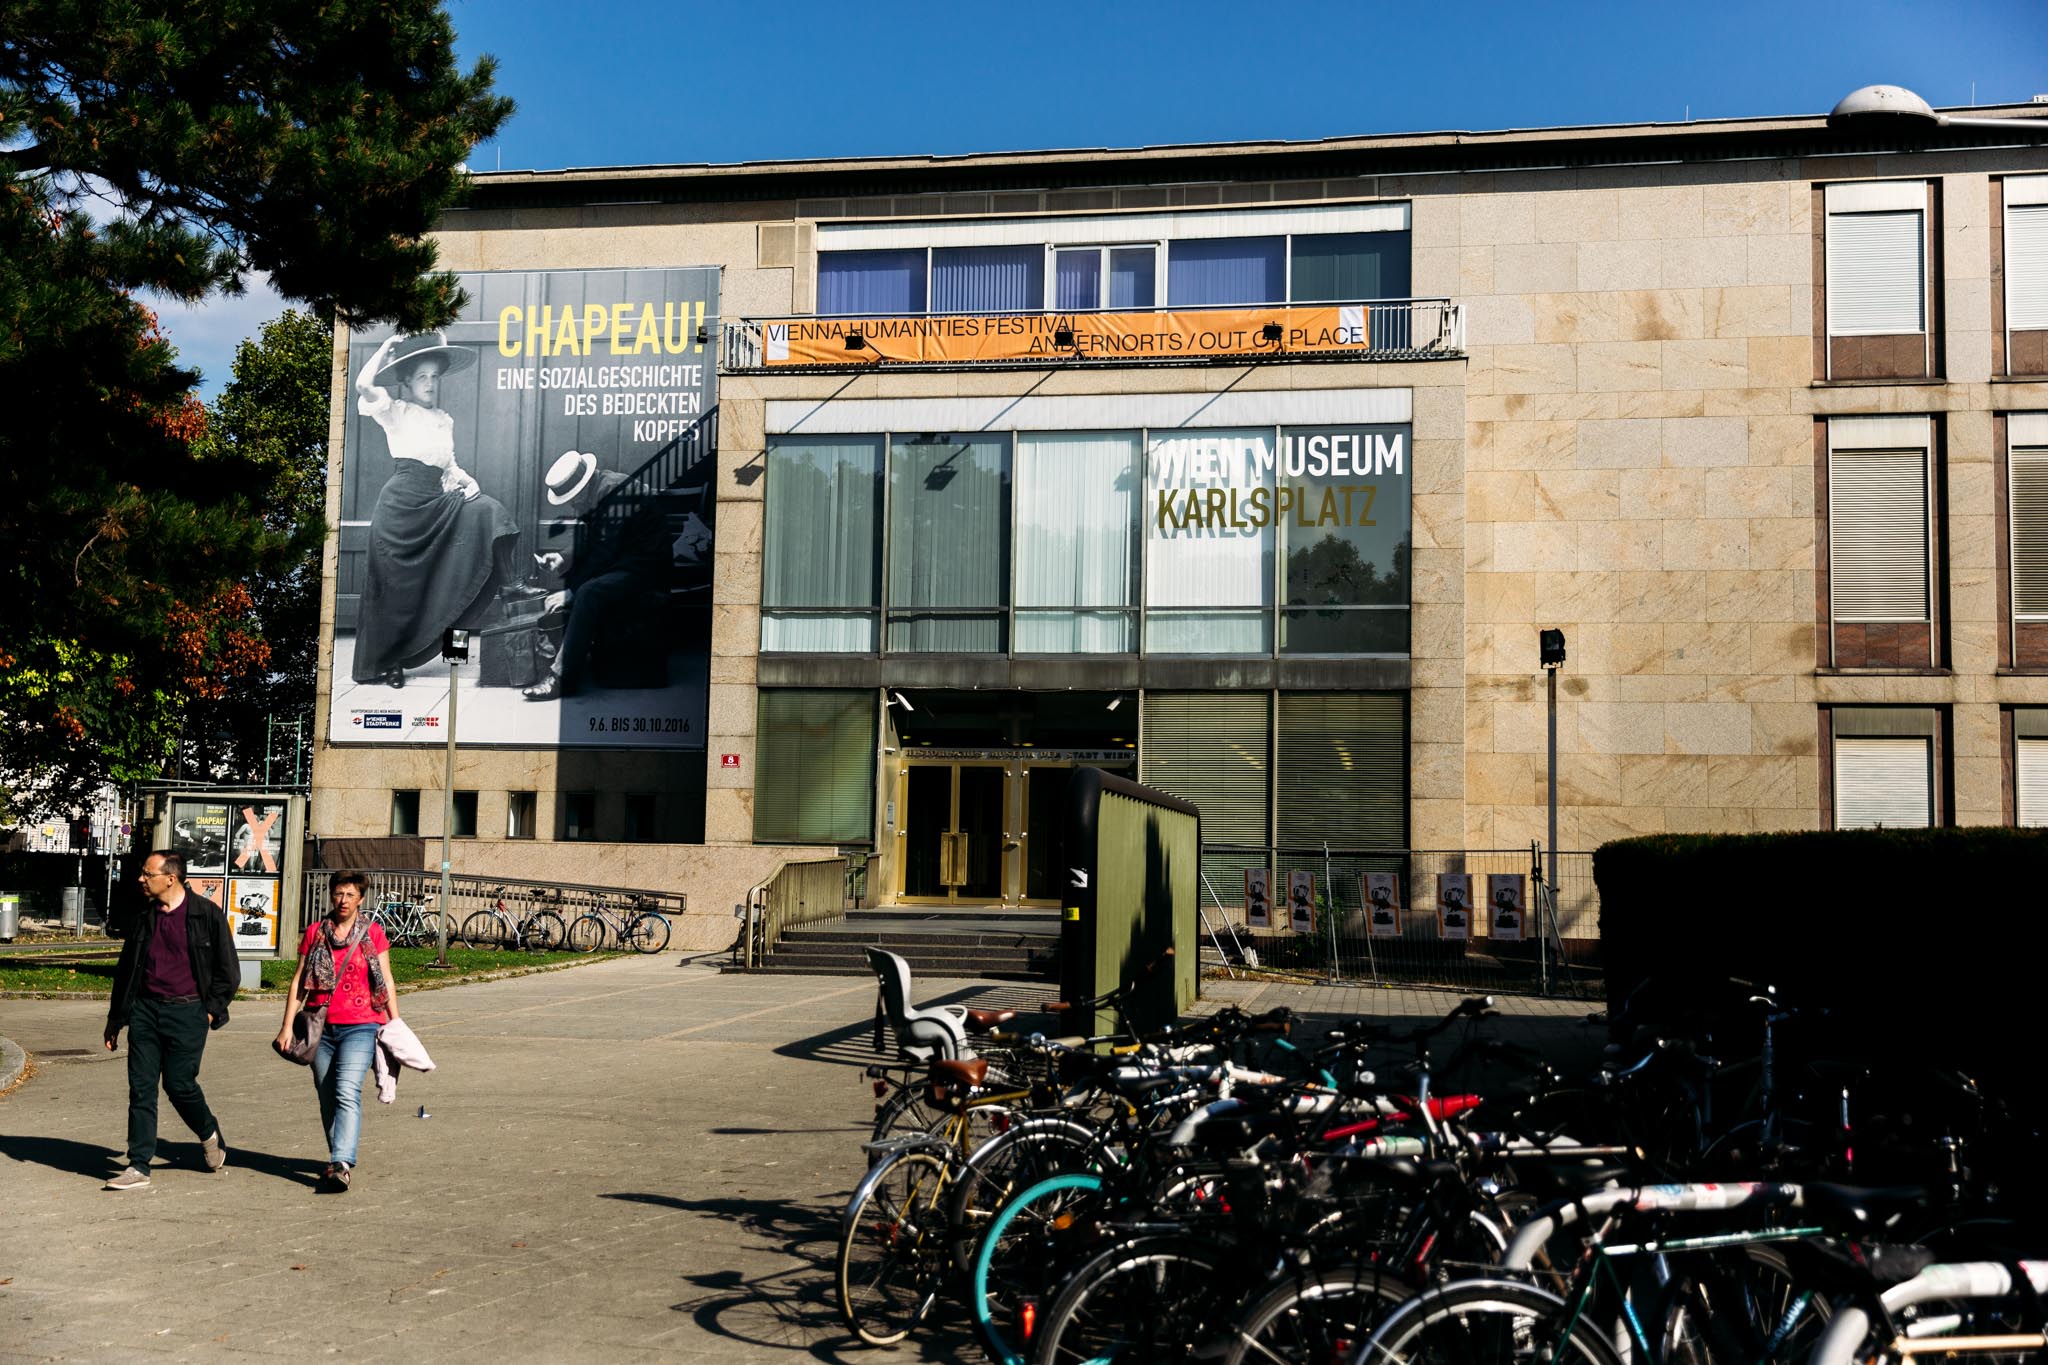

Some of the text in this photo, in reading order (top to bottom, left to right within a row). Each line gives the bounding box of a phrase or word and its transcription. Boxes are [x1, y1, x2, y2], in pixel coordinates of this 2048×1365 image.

[498, 301, 706, 358] CHAPEAU!
[768, 315, 1084, 341] VIENNA HUMANITIES FESTIVAL
[1200, 331, 1248, 350] OUT
[1290, 326, 1365, 346] PLACE
[497, 365, 702, 389] EINE SOZIALGESCHICHTE
[564, 392, 701, 416] DES BEDECKTEN
[634, 420, 700, 442] KOPFES
[1150, 434, 1404, 479] WIEN MUSEUM
[1158, 485, 1377, 529] KARLSPLATZ
[590, 717, 690, 733] 9.6. BIS 30.10.2016
[1103, 751, 1131, 760] WIEN
